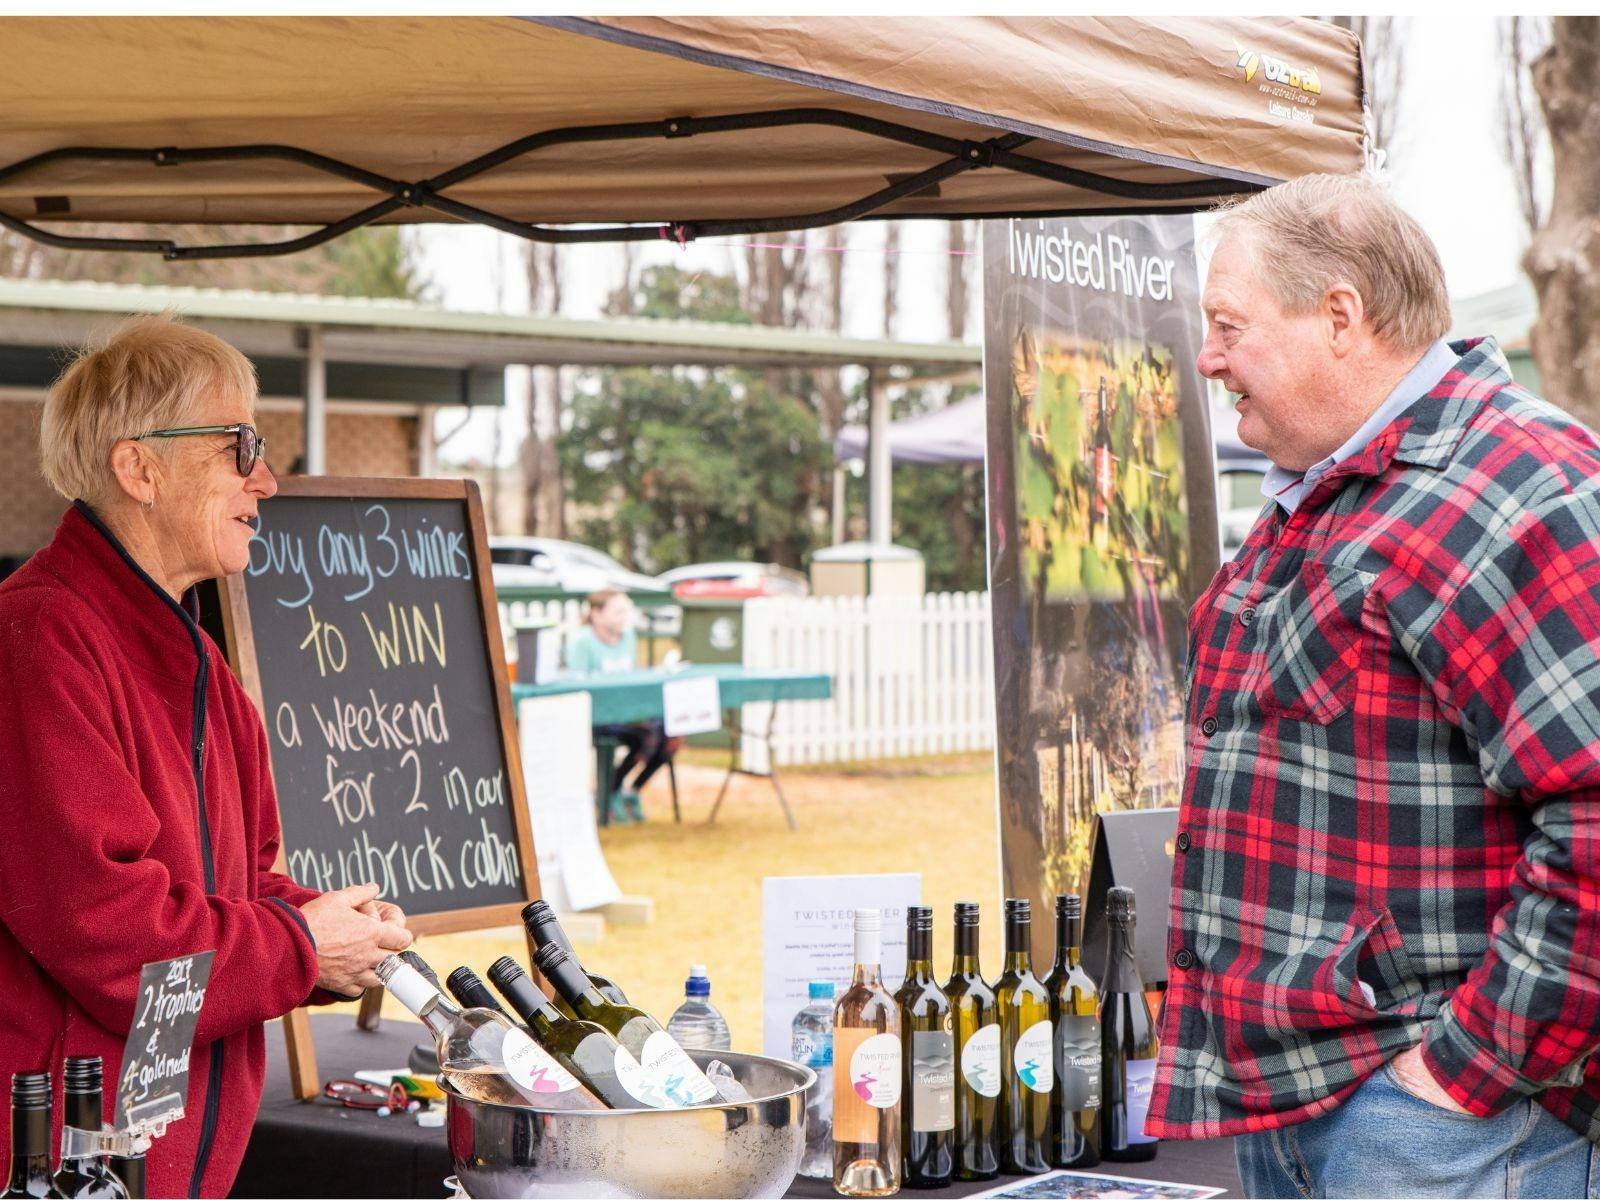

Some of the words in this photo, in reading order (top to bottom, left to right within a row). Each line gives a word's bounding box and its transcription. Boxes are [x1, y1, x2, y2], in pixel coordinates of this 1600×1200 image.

[1269, 100, 1292, 120] Leisure
[1008, 217, 1106, 291] Twisted
[1107, 234, 1176, 301] River
[247, 513, 314, 608] Buy
[318, 524, 375, 602] any
[364, 503, 400, 578] 3
[401, 517, 473, 581] wines
[299, 604, 348, 677] to
[361, 602, 447, 670] WIN
[276, 701, 303, 748] a
[311, 683, 450, 752] weekend
[322, 754, 376, 827] for
[400, 749, 429, 815] 2
[438, 760, 473, 815] in
[474, 769, 505, 807] our
[460, 817, 520, 889] cabin
[794, 907, 855, 922] TWISTED
[165, 957, 194, 982] 2017
[136, 985, 154, 1029] 2
[154, 979, 206, 1027] trophies
[146, 1028, 161, 1057] &
[134, 1053, 167, 1102] gold
